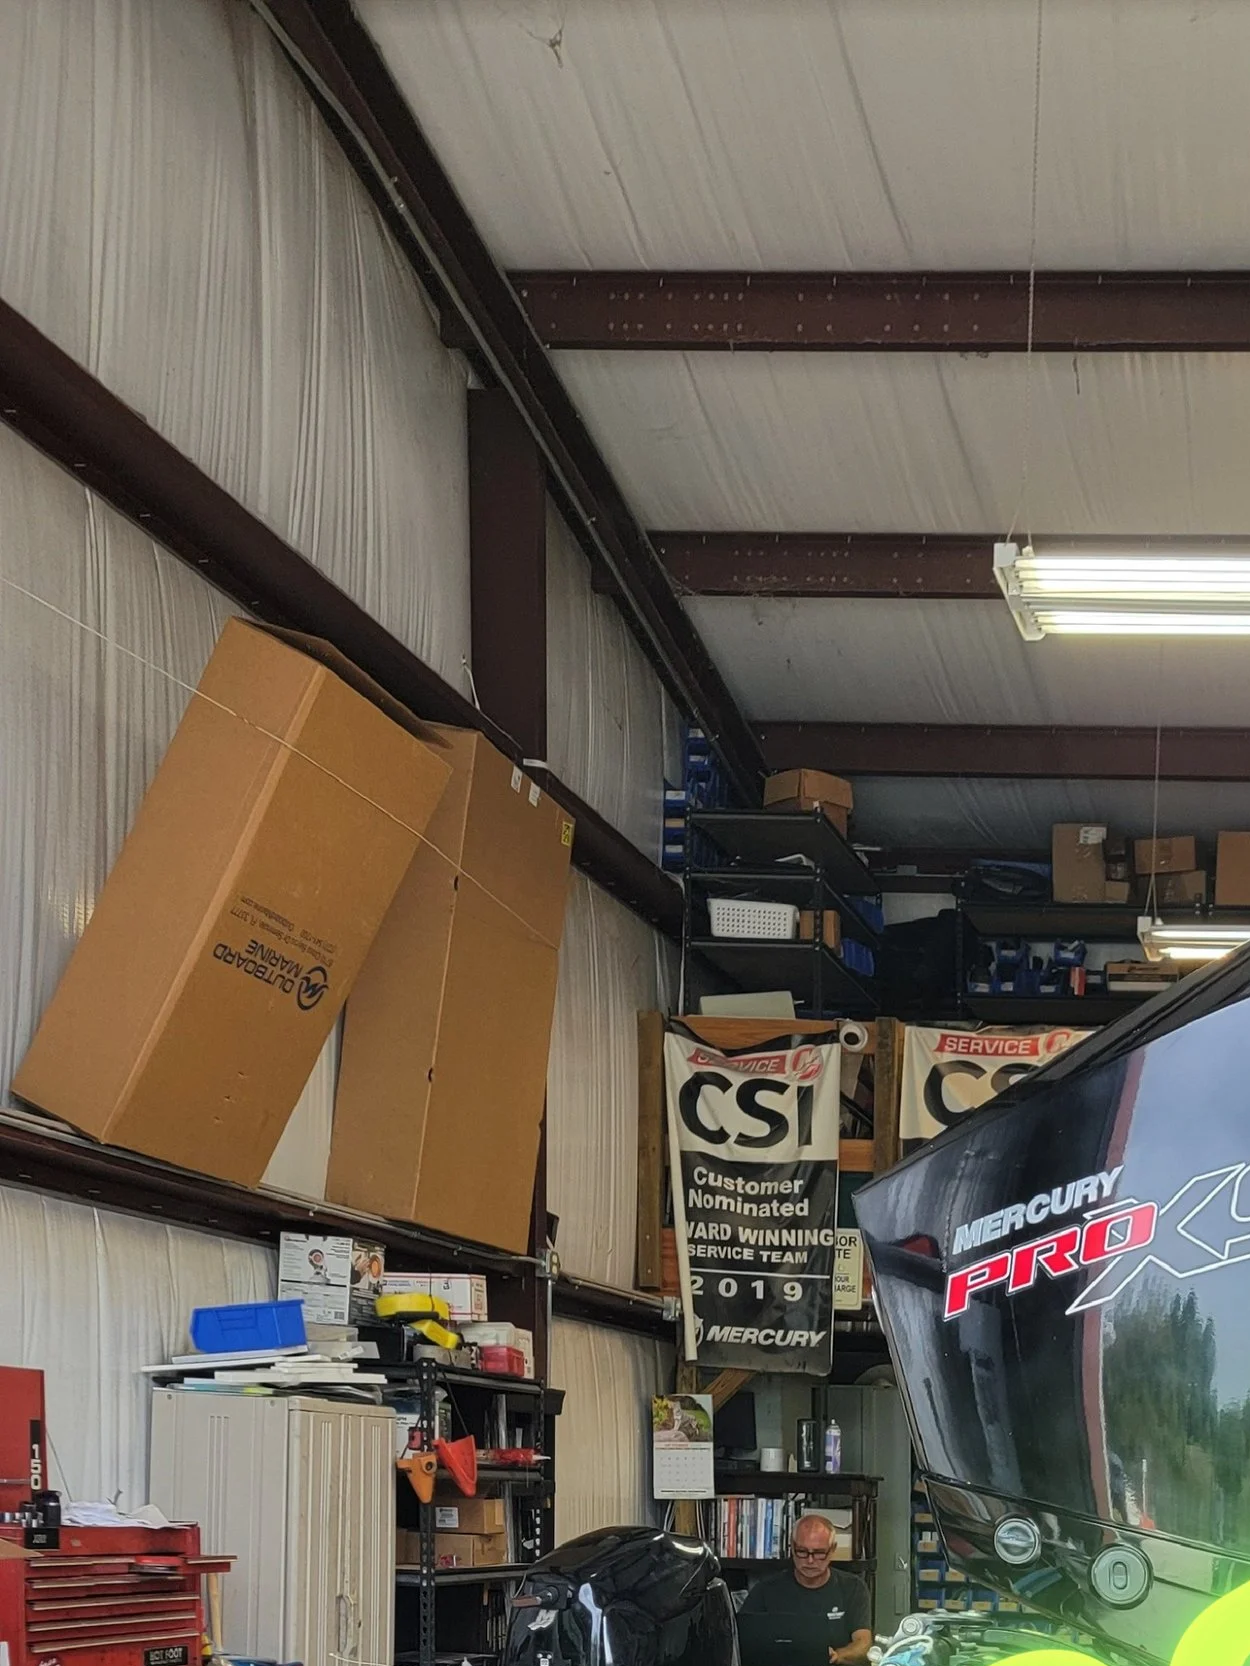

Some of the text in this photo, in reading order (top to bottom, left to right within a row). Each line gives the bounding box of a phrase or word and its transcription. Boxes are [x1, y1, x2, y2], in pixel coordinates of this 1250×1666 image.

[213, 943, 295, 994] OUTBOARD
[245, 939, 304, 978] MARINE
[944, 1037, 1032, 1054] SERVICE
[679, 1071, 814, 1149] CSI
[693, 1166, 804, 1196] Customer
[687, 1188, 809, 1218] Nominated
[951, 1164, 1125, 1257] MERCURY
[738, 1226, 835, 1247] WINNING
[687, 1244, 808, 1264] SERVICE TEAM
[943, 1201, 1160, 1323] PRO
[706, 1325, 827, 1348] MERCURY
[30, 1443, 42, 1490] 150
